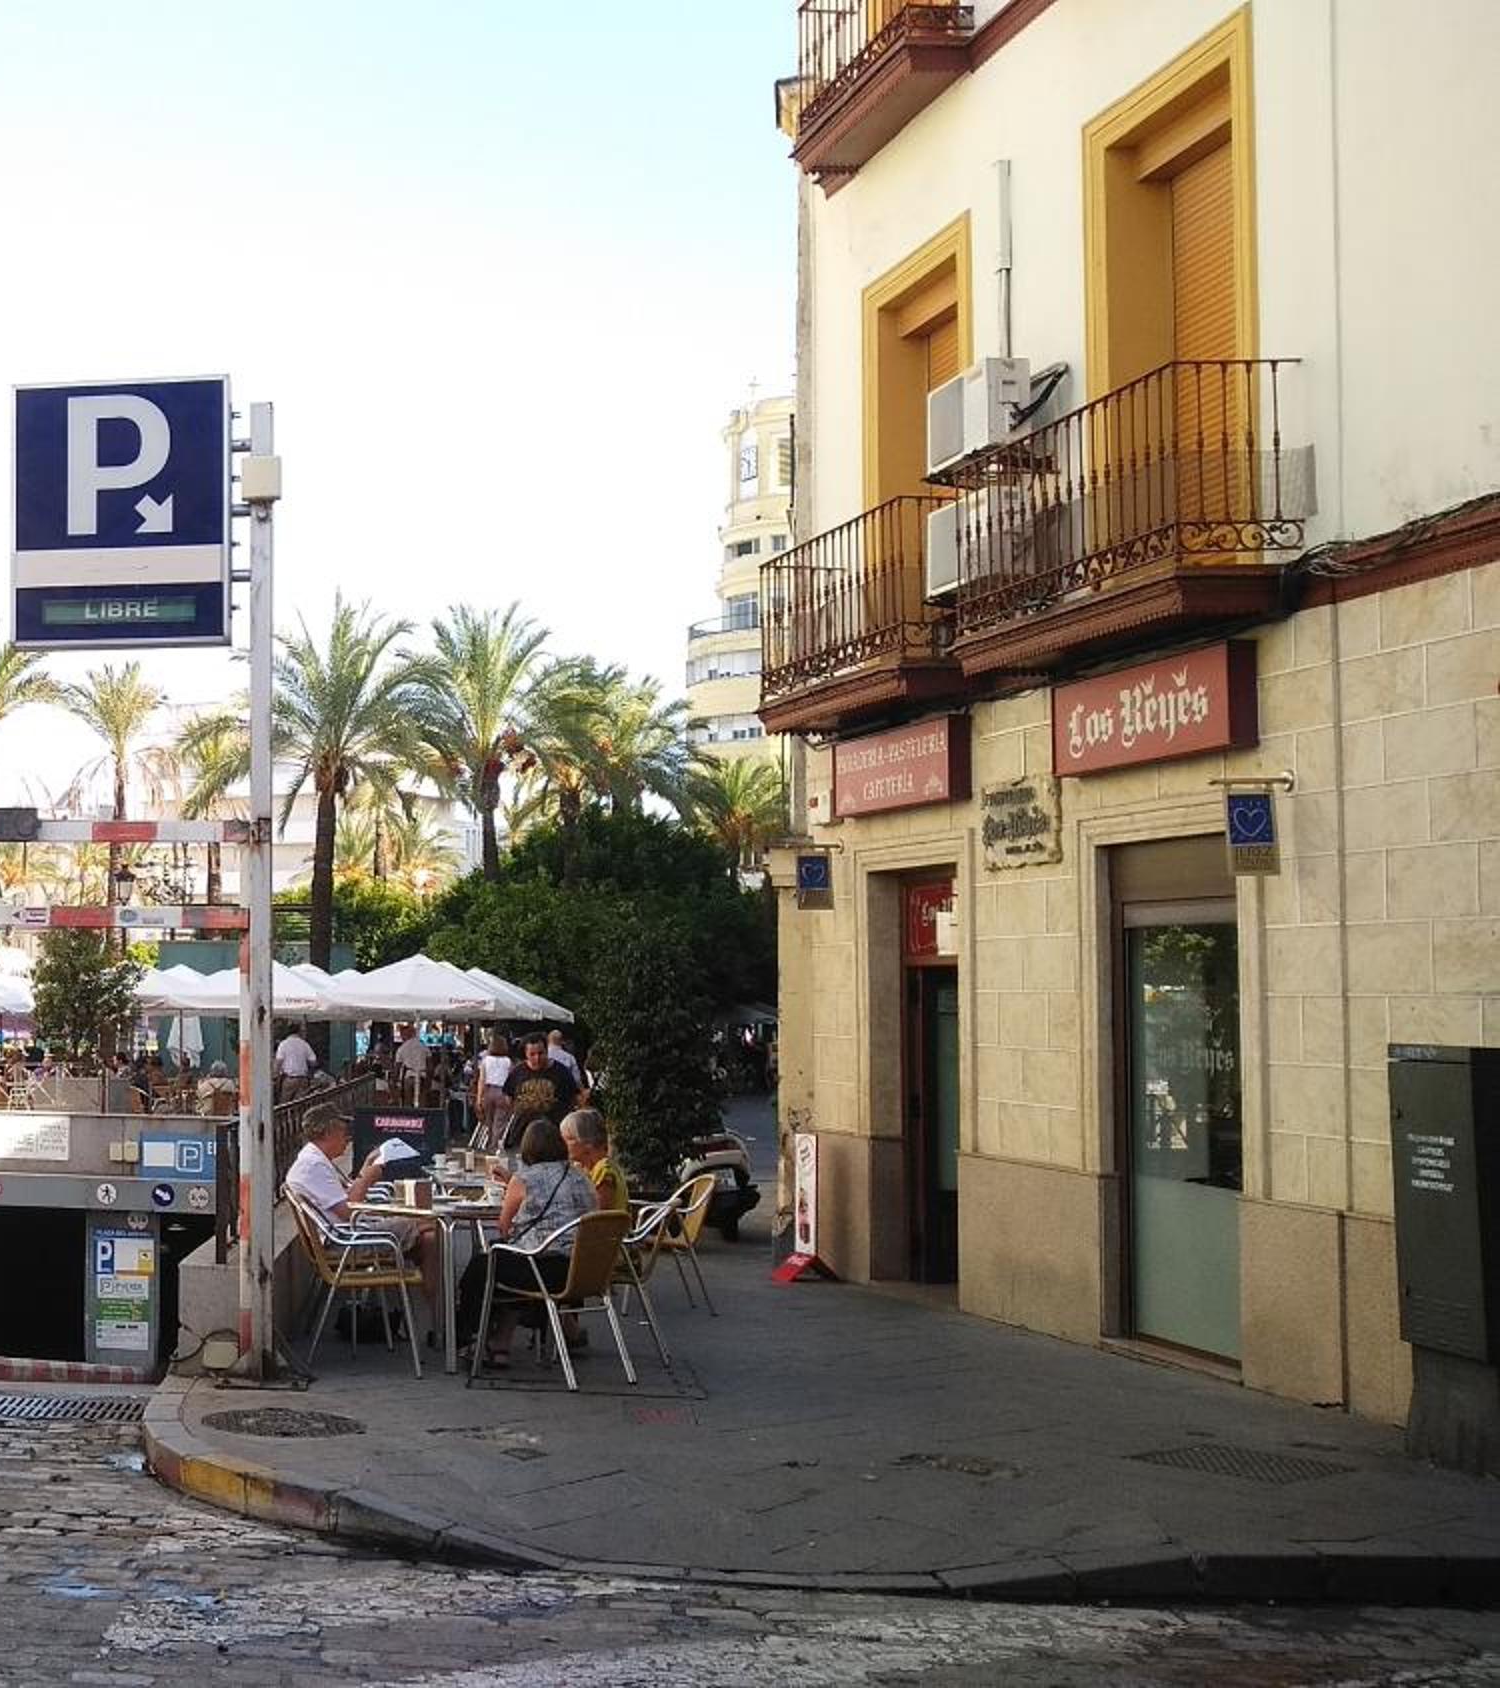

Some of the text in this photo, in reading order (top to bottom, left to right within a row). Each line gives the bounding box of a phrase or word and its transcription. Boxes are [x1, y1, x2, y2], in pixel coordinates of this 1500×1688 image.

[67, 394, 172, 535] P
[84, 600, 159, 619] LIBRE
[1068, 680, 1210, 759] Los Reyes
[183, 1145, 199, 1168] P
[97, 1241, 113, 1273] P
